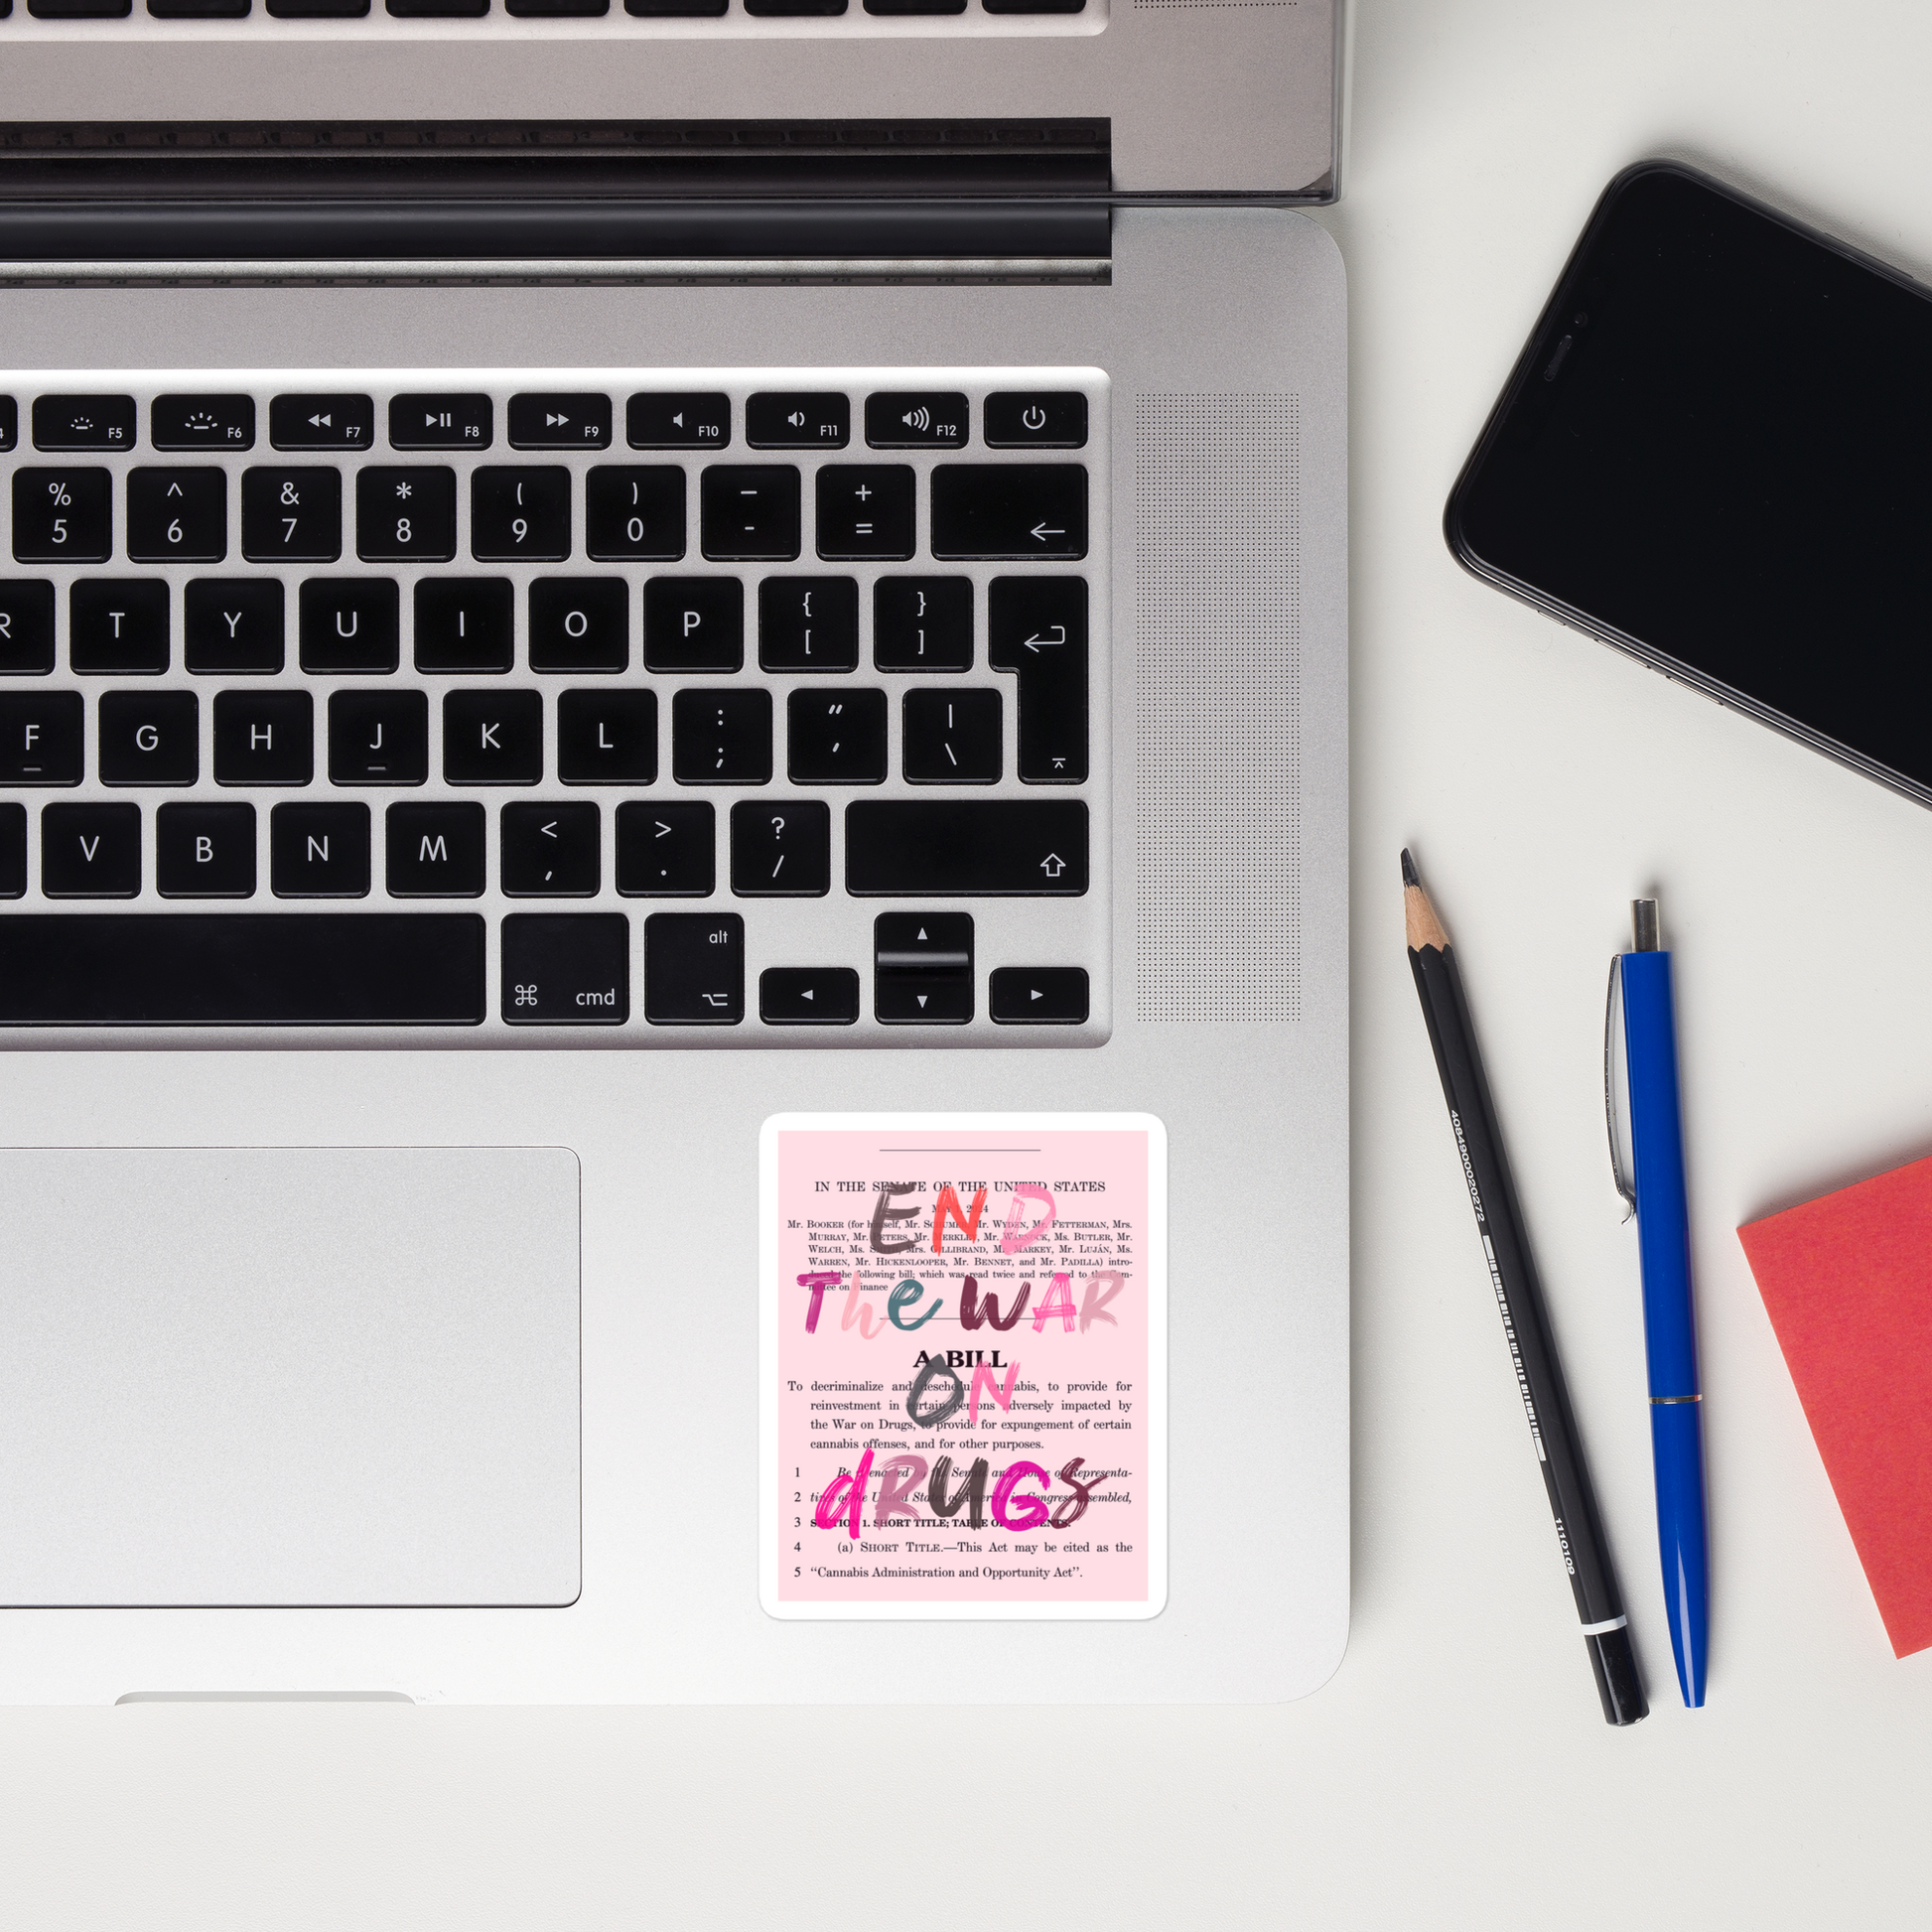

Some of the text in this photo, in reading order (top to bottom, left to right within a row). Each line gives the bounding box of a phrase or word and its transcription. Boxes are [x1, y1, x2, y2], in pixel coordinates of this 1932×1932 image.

[108, 427, 123, 439] F5
[227, 427, 242, 439] F6
[345, 426, 361, 438] F7
[465, 425, 480, 438] F8
[584, 426, 600, 438] F9
[698, 425, 719, 437] F10
[820, 425, 838, 437] F11
[936, 424, 957, 436] F12
[52, 518, 68, 544] 5
[167, 518, 183, 543] 6
[281, 517, 298, 543] 7
[396, 517, 412, 543] 8
[512, 518, 528, 543] 9
[626, 517, 644, 542] 0
[108, 612, 125, 638] T
[223, 612, 242, 638] Y
[337, 611, 357, 637] U
[459, 611, 466, 637] I
[564, 611, 588, 637] O
[683, 611, 701, 637] P
[25, 724, 40, 751] F
[136, 725, 159, 752] G
[250, 724, 272, 751] H
[369, 723, 382, 750] J
[482, 723, 501, 750] K
[599, 722, 614, 749] L
[79, 835, 100, 862] V
[196, 836, 213, 863] B
[307, 835, 329, 862] N
[419, 835, 448, 862] M
[709, 929, 729, 944] alt
[576, 988, 616, 1006] cmd
[1451, 1110, 1485, 1222] 4084900020272
[815, 1181, 1105, 1192] IN THE SENATE OF THE UNITED STATES
[870, 1181, 1056, 1255] END
[838, 1270, 852, 1279] the
[899, 1270, 916, 1282] bill;
[969, 1270, 988, 1279] read
[796, 1270, 943, 1339] The
[913, 1350, 1007, 1367] A BILL
[787, 1381, 1132, 1393] To decriminalize and cannabis, to provide for
[905, 1354, 1021, 1427] ON
[811, 1400, 881, 1410] reinvestment
[890, 1400, 899, 1410] in
[1003, 1401, 1053, 1412] adversely
[1061, 1400, 1110, 1413] impacted
[1119, 1400, 1132, 1413] by
[811, 1419, 828, 1429] the
[832, 1419, 856, 1429] War
[879, 1418, 917, 1432] Drugs,
[936, 1420, 976, 1431] provide
[981, 1419, 997, 1429] for
[1002, 1421, 1074, 1432] expungement
[1078, 1420, 1090, 1429] of
[1094, 1419, 1131, 1429] certain
[810, 1439, 1043, 1450] cannabis offenses, and for other purposes.
[794, 1467, 801, 1477] 1
[837, 1467, 851, 1477] Be
[794, 1492, 1072, 1504] 2 United Congress
[794, 1517, 800, 1527] 3
[874, 1517, 911, 1527] SHORT
[913, 1516, 951, 1528] TITLE;
[794, 1542, 801, 1552] 4
[838, 1543, 853, 1553] (a)
[989, 1542, 1008, 1552] Act
[1015, 1545, 1037, 1555] may
[1044, 1542, 1056, 1552] be
[1063, 1542, 1089, 1552] cited
[1116, 1542, 1133, 1552] the
[1555, 1517, 1576, 1576] 1110109
[794, 1567, 800, 1577] 5
[872, 1567, 955, 1577] Administration
[959, 1567, 979, 1577] and
[983, 1567, 1050, 1580] Opportunity
